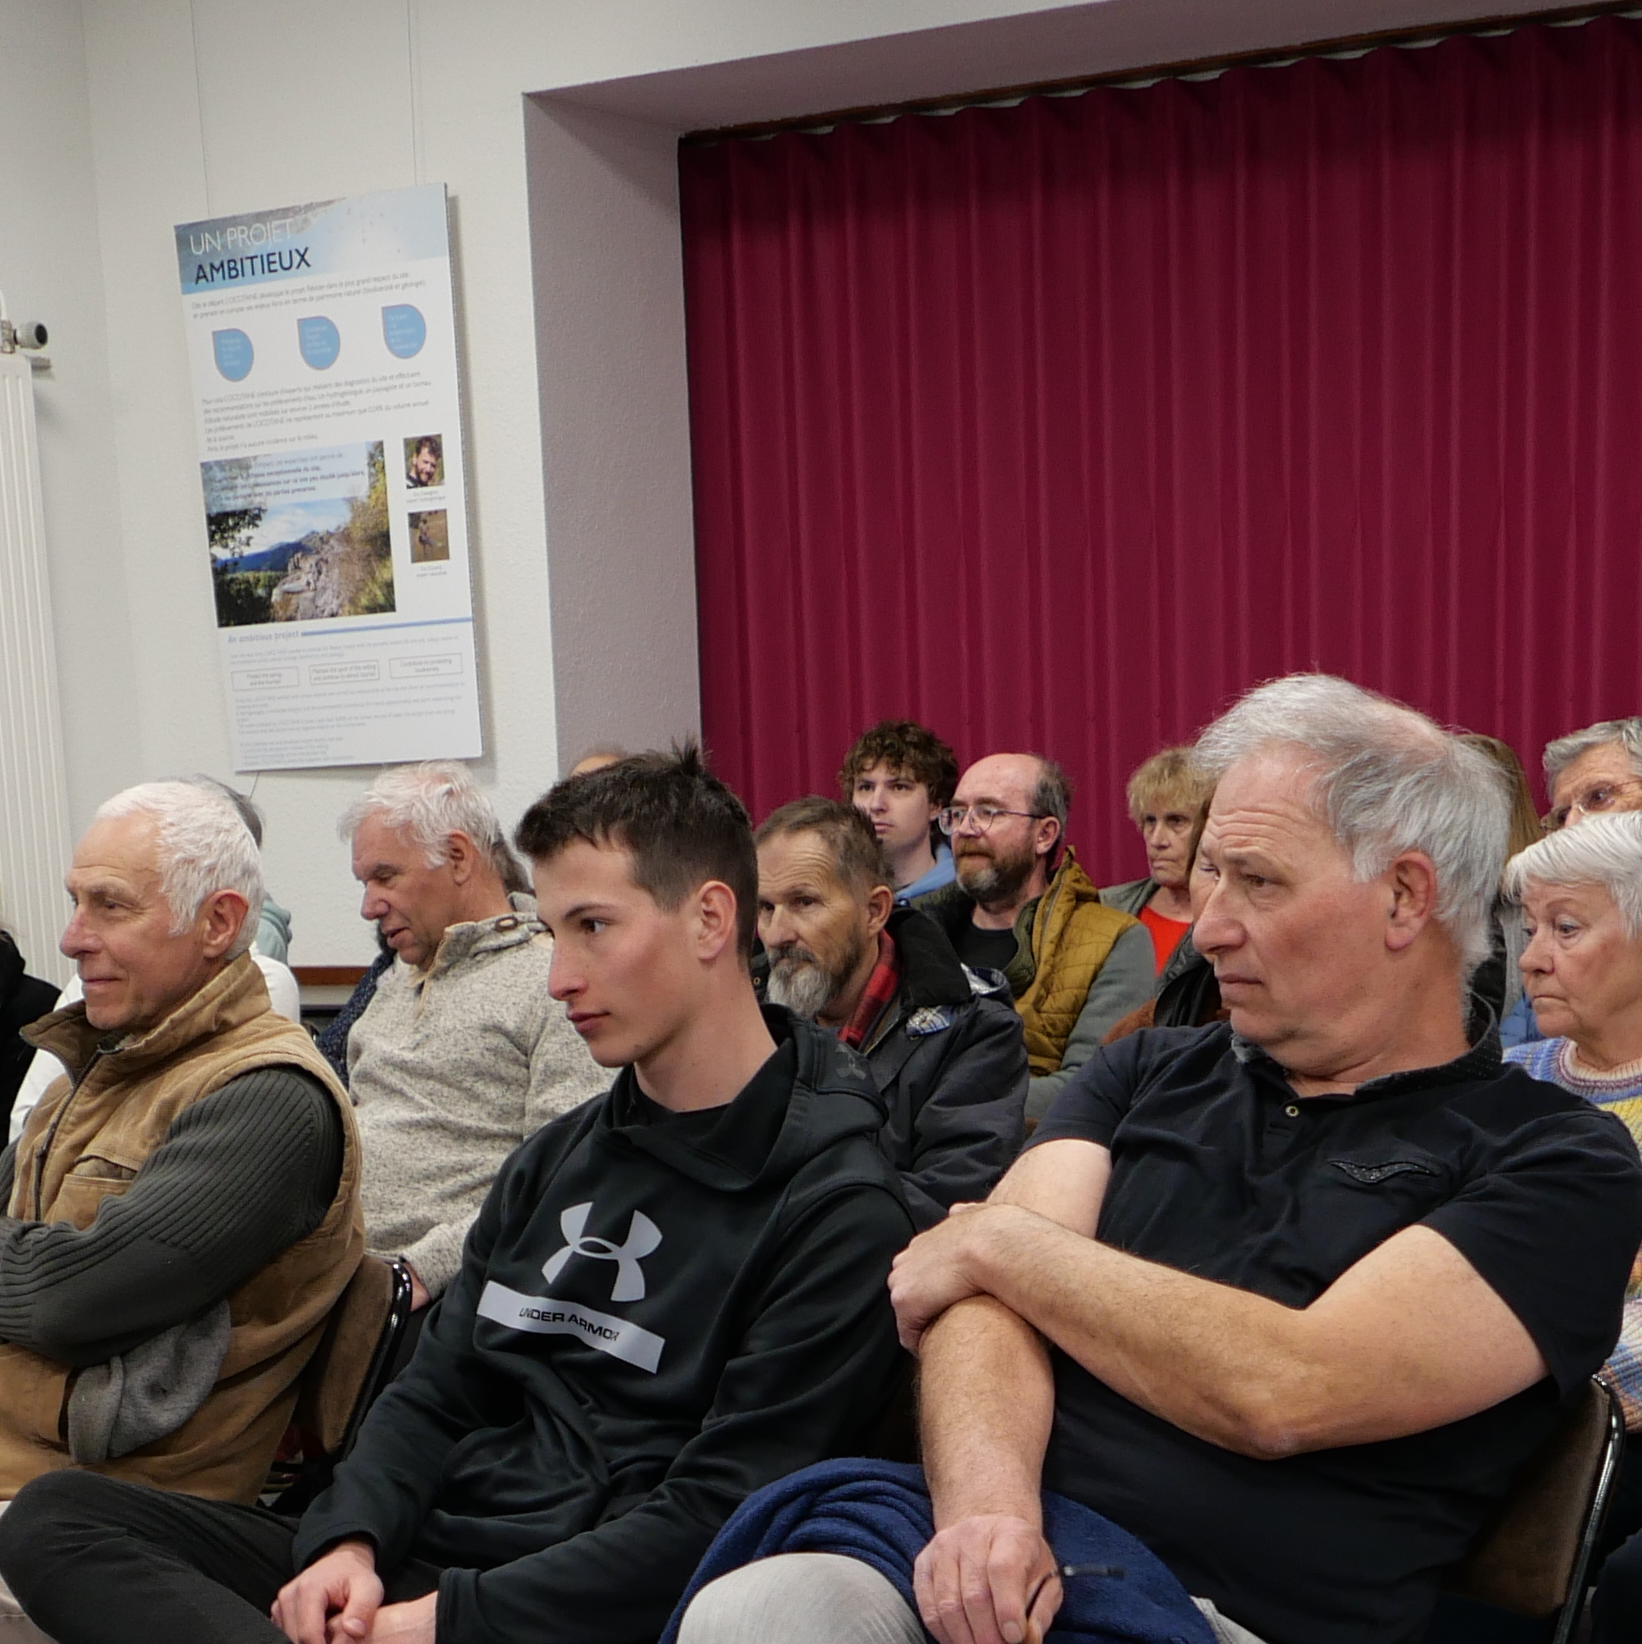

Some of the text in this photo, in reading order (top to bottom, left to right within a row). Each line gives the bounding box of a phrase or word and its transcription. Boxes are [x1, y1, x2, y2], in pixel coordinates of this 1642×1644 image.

[189, 218, 294, 255] UN PROJET
[194, 246, 312, 285] AMBITIEUX
